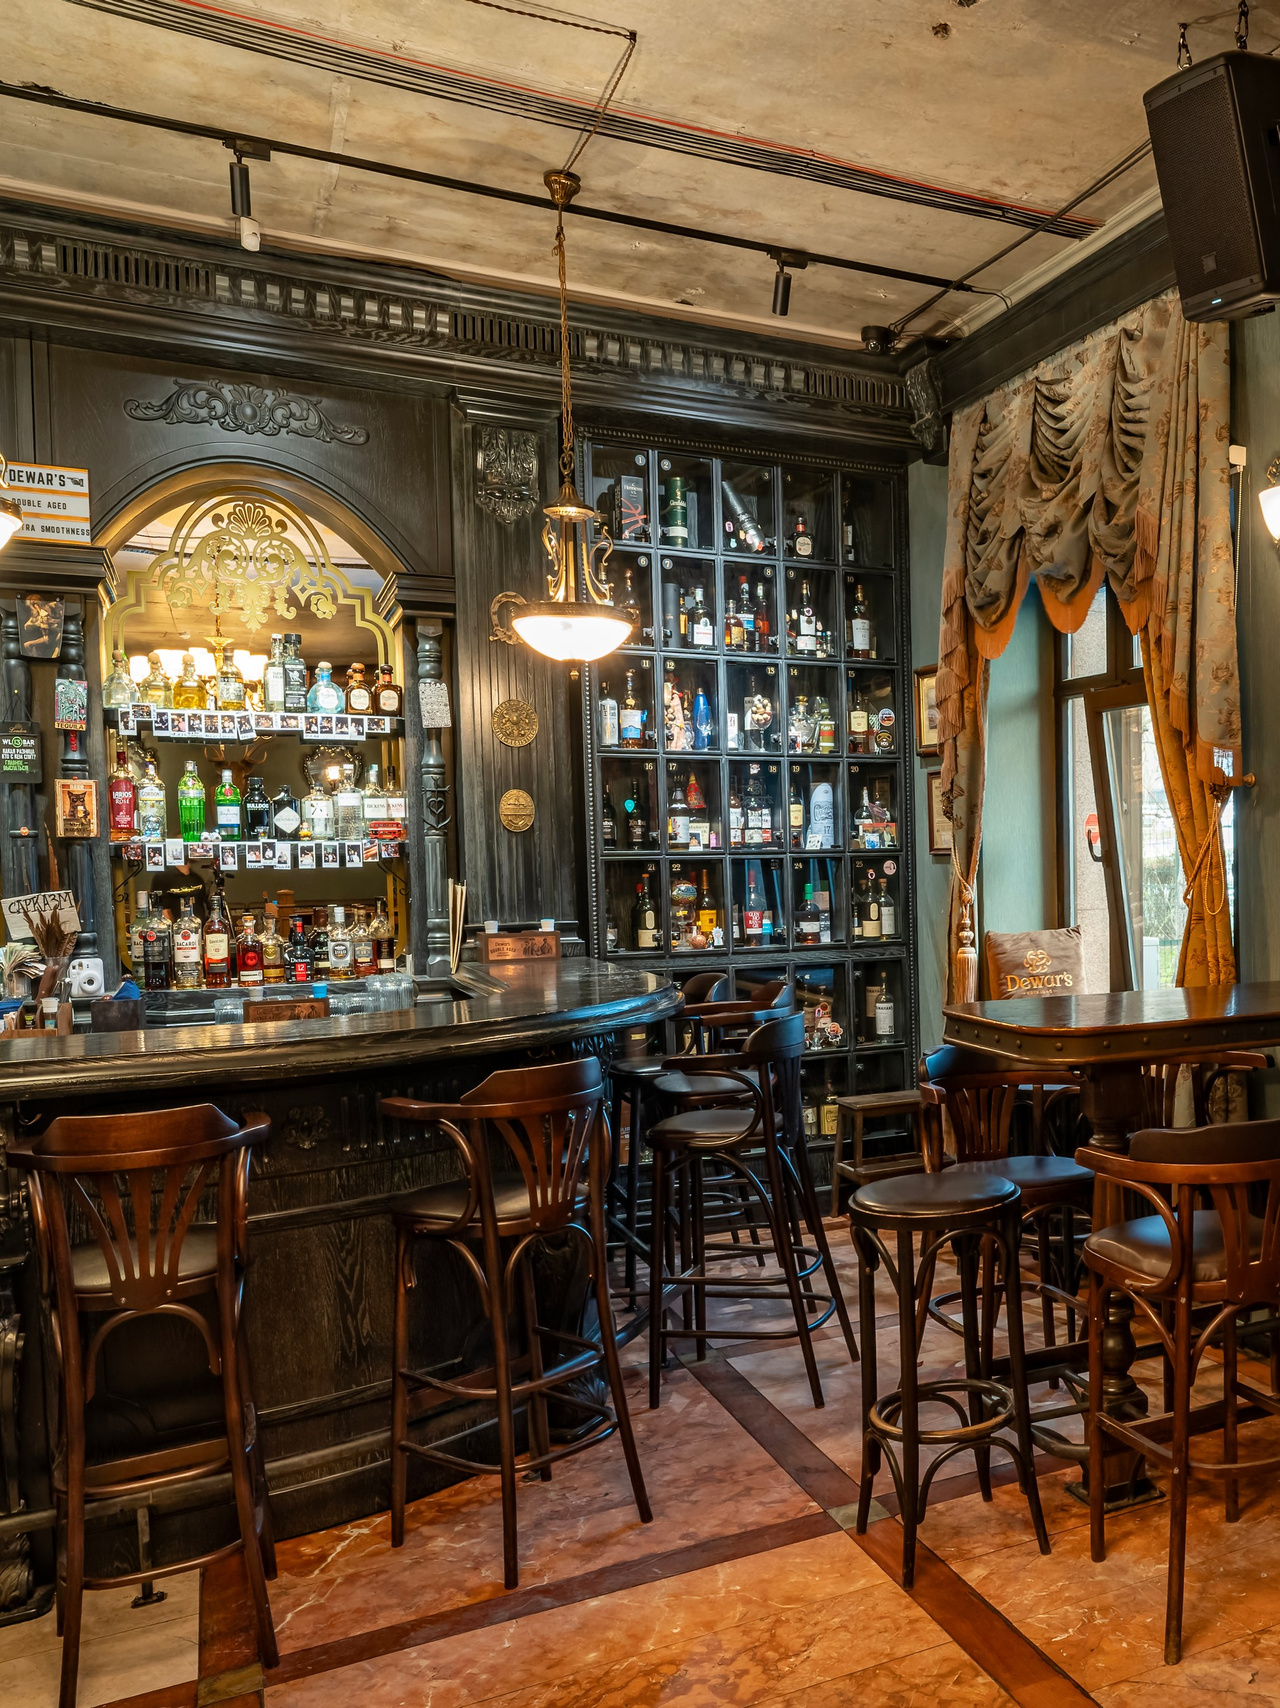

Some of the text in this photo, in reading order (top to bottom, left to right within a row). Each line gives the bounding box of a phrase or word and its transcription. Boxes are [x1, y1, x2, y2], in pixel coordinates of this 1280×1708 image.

[9, 469, 66, 487] DEWAR'S
[763, 472, 769, 480] 3
[11, 498, 67, 510] DOUBLE AGED
[21, 523, 90, 536] TRA SMOOTHNESS
[664, 560, 670, 568] 7
[766, 568, 771, 576] 8
[642, 660, 650, 668] 11
[666, 661, 675, 669] 12
[767, 667, 775, 675] 13
[56, 722, 85, 730] TEQUILA
[112, 791, 132, 799] LARIOS
[8, 891, 75, 915] САРКАЗМ
[489, 946, 505, 954] DOUBLE
[1005, 971, 1073, 992] Dewar's
